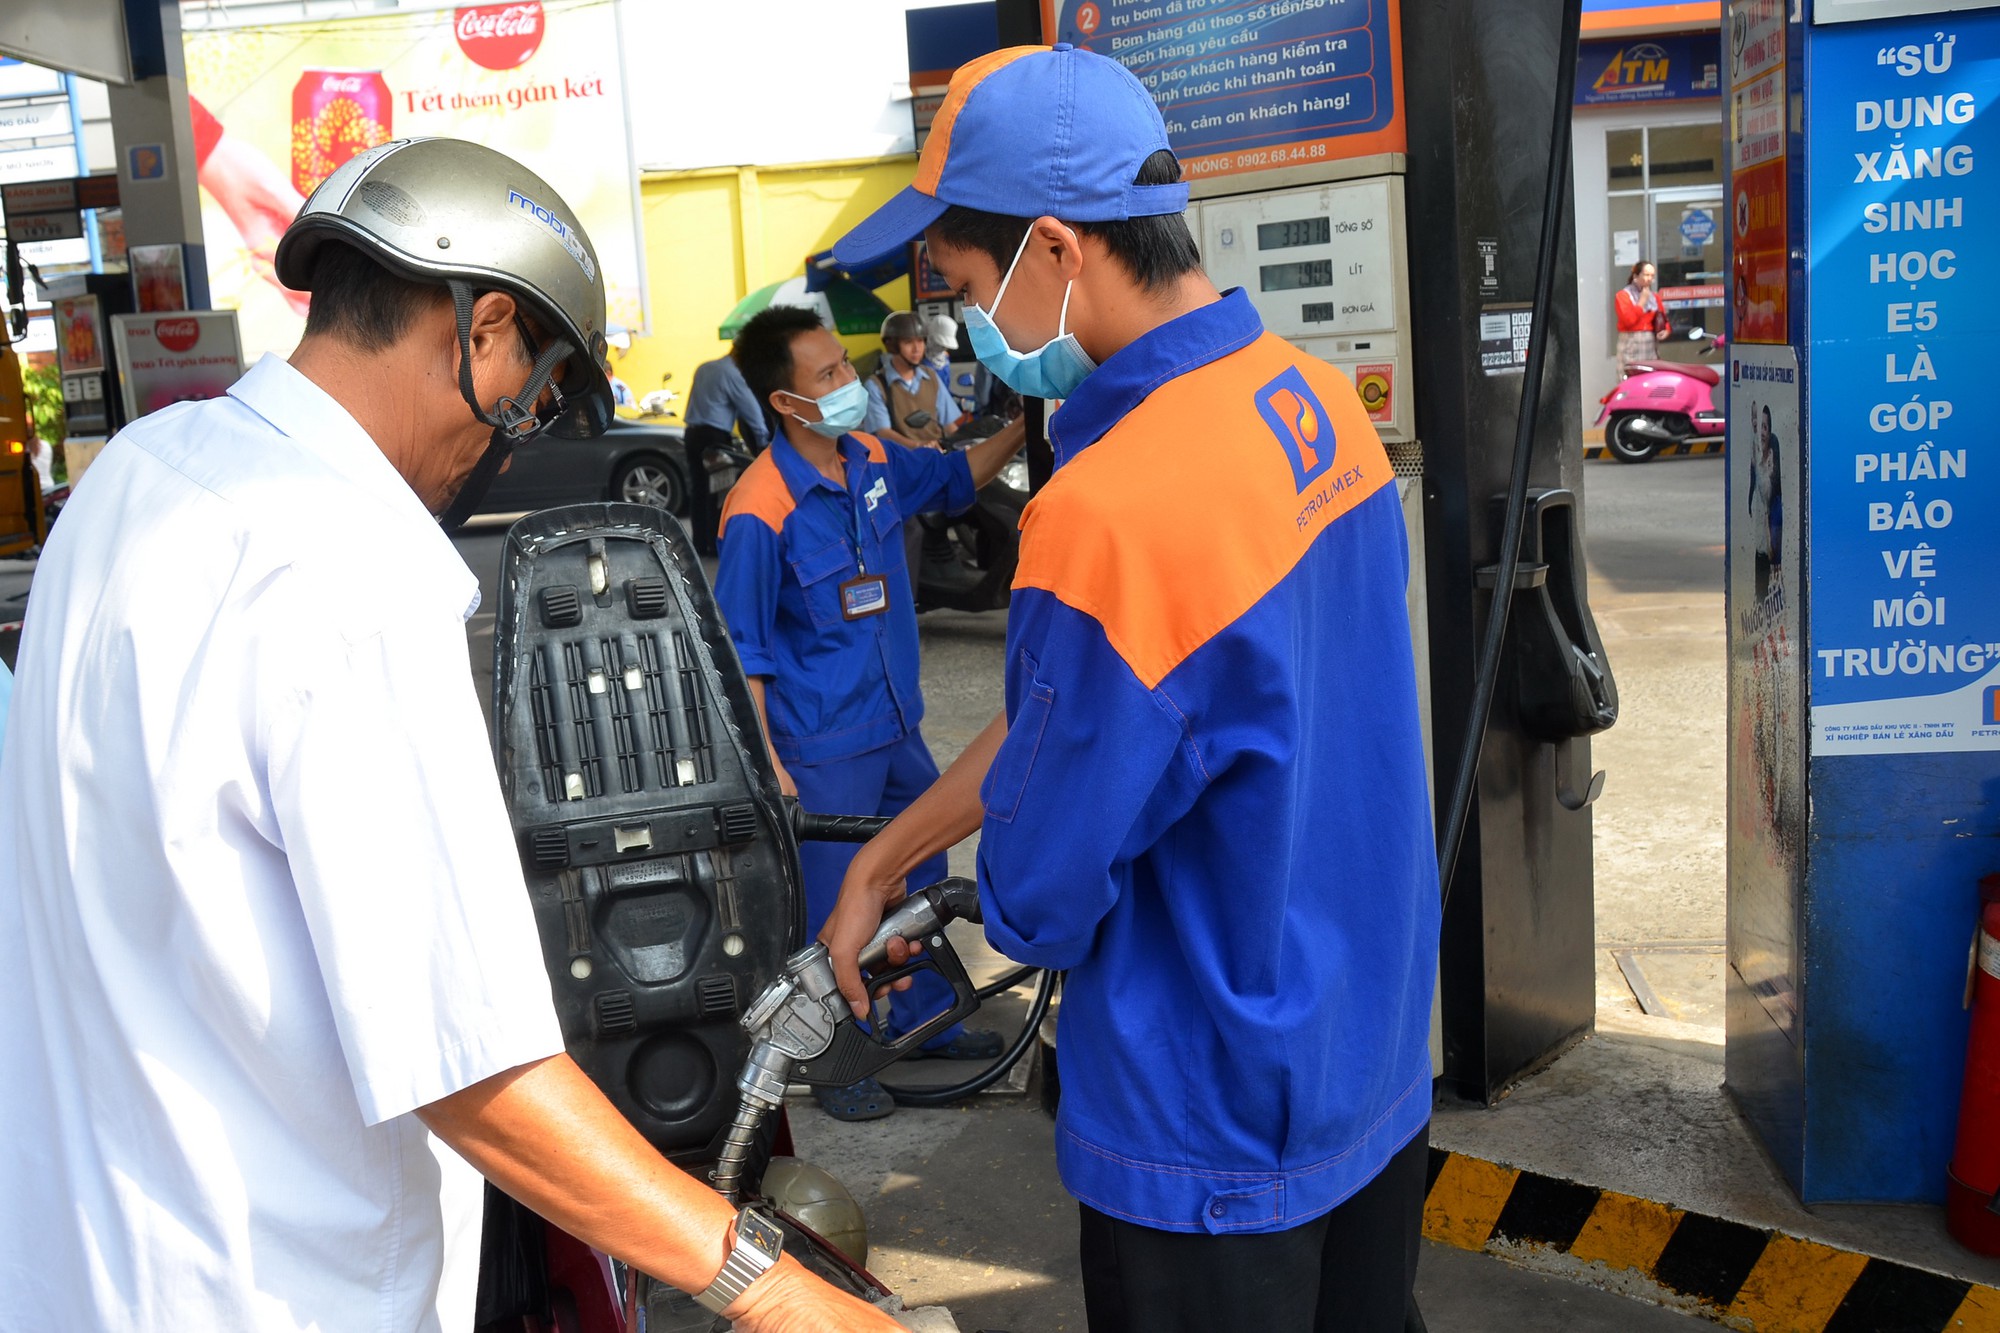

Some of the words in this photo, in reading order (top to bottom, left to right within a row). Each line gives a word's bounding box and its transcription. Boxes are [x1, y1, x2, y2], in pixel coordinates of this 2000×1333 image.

[1081, 7, 1094, 30] 2
[1111, 15, 1129, 27] trụ
[1133, 8, 1162, 22] bơm
[1166, 1, 1183, 14] đã
[1112, 36, 1143, 50] Bơm
[1147, 26, 1183, 41] hàng
[1187, 19, 1206, 34] đủ
[1210, 14, 1243, 29] theo
[1248, 4, 1267, 22] số
[1158, 43, 1195, 59] hàng
[1199, 35, 1226, 53] yêu
[1230, 29, 1259, 45] cầu
[1161, 68, 1187, 82] báo
[1190, 57, 1235, 77] khách
[1239, 51, 1278, 68] hàng
[1282, 41, 1321, 60] kiểm
[1325, 39, 1348, 52] tra
[1182, 80, 1220, 97] trước
[1224, 74, 1247, 91] khi
[1251, 67, 1296, 86] thanh
[1300, 61, 1336, 77] toán
[1592, 49, 1670, 89] ATM
[401, 86, 445, 113] Tết
[507, 75, 558, 111] gắn
[565, 71, 605, 99] kết
[1191, 114, 1222, 130] cảm
[1226, 110, 1245, 124] ơn
[1249, 103, 1298, 121] khách
[1303, 92, 1351, 114] hàng!
[1856, 92, 1975, 139] DỤNG
[1236, 144, 1327, 168] 0902.68.44.88
[1853, 142, 1974, 184] XĂNG
[1334, 221, 1358, 234] TỔNG
[1361, 219, 1375, 231] SỐ
[1863, 197, 1963, 234] SINH
[1349, 262, 1363, 276] LÍT
[1870, 249, 1956, 290] HỌC
[1342, 304, 1360, 315] ĐƠN
[1360, 302, 1375, 313] GIÁ
[1887, 301, 1938, 333] E5
[1886, 344, 1937, 383] LÀ
[1869, 394, 1953, 433] GÓP
[1855, 441, 1966, 483] PHẦN
[1296, 465, 1364, 533] PETROLIMEX
[1868, 490, 1953, 532] BẢO
[1881, 542, 1937, 587] VỆ
[1873, 591, 1946, 628] MÔI
[1824, 724, 1841, 732] CÔNG
[1852, 723, 1869, 732] XĂNG
[1837, 733, 1870, 742] NGHIỆP
[1872, 731, 1891, 740] BÁN
[1908, 730, 1933, 739] XĂNG
[1935, 728, 1955, 738] DẦU
[1971, 729, 2000, 737] PETR
